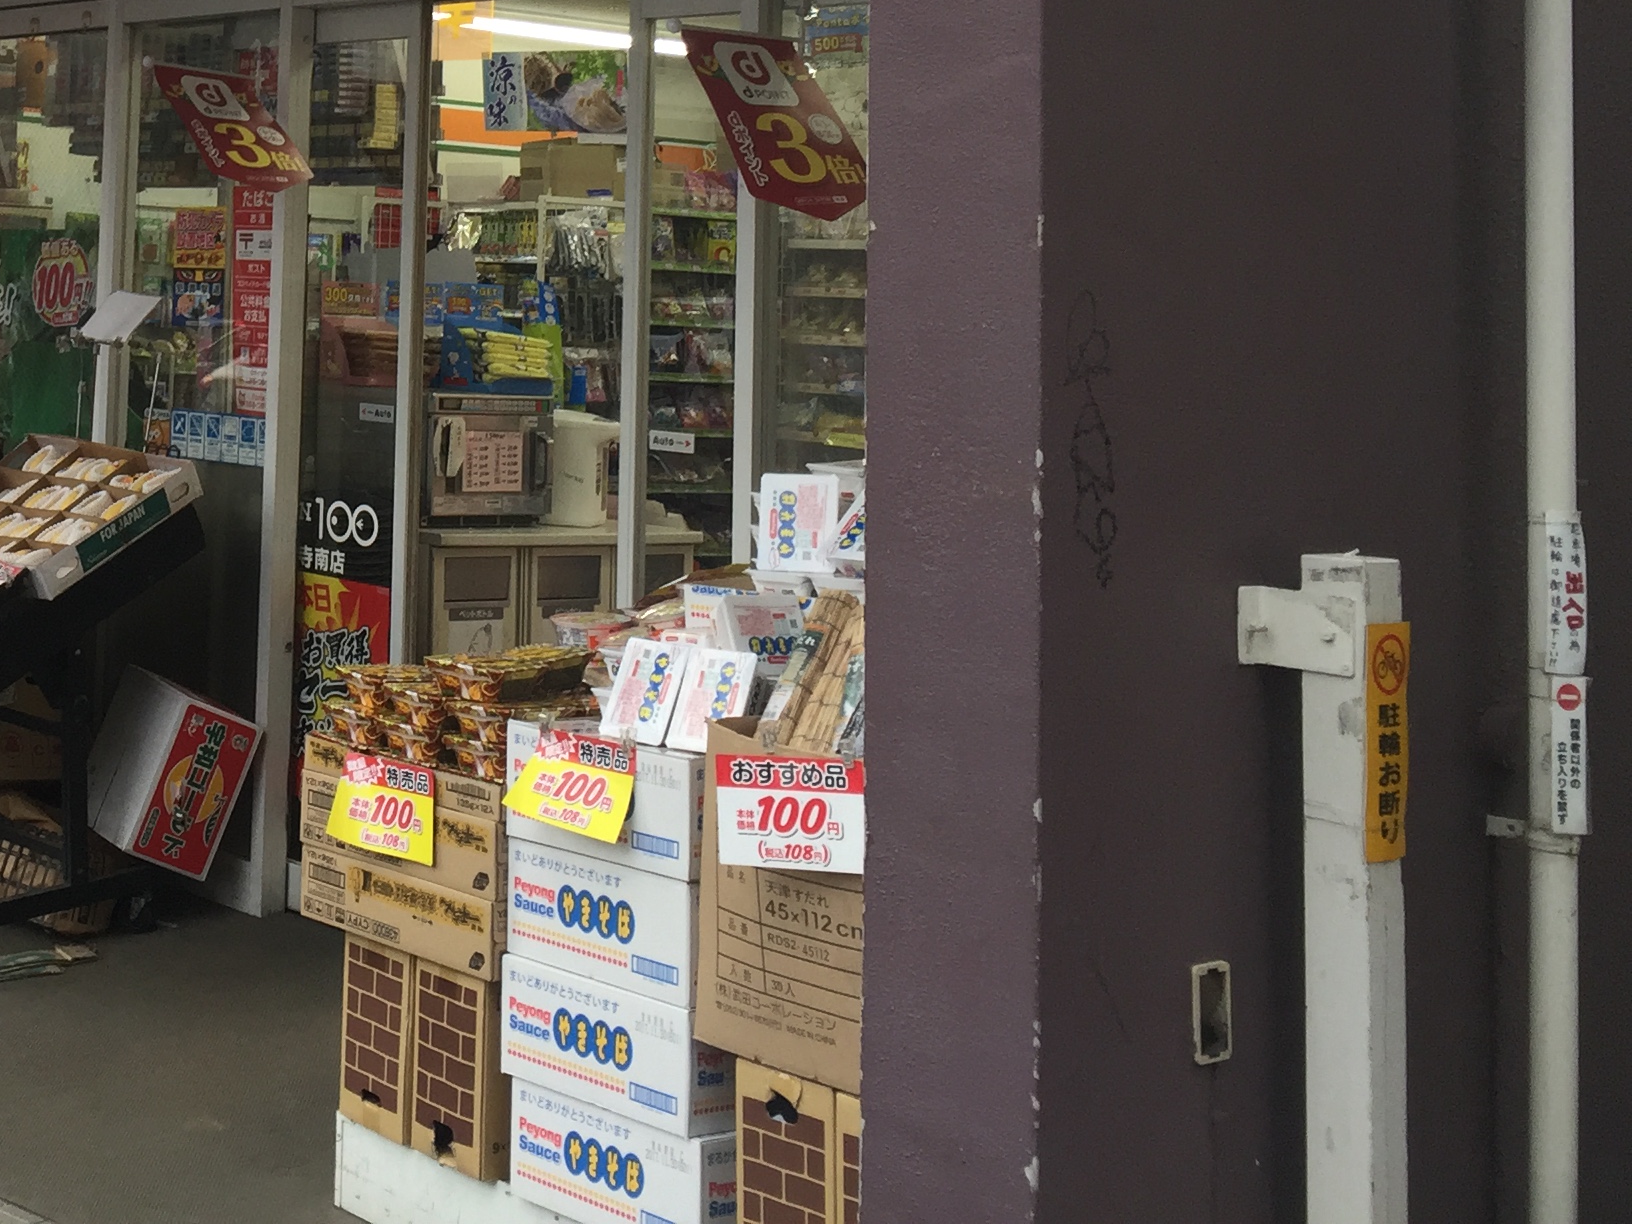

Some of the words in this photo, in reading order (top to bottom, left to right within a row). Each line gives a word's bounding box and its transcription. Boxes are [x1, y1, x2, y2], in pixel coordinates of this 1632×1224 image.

[814, 36, 839, 52] 500
[242, 190, 274, 208] たばこ
[374, 408, 392, 419] Auto
[652, 434, 675, 448] Auto
[99, 523, 118, 543] FOR
[118, 504, 146, 532] JAPAN
[315, 497, 379, 547] 100
[458, 609, 495, 619] ペットボトル
[579, 740, 629, 772] 特売品
[1570, 718, 1581, 790] 関係者以外の
[386, 764, 430, 794] 特売品
[533, 782, 552, 795] 価格
[538, 773, 556, 785] 本体
[731, 760, 848, 791] おすすめ品
[1377, 702, 1402, 845] 駐輪お断り
[351, 797, 370, 809] 本体
[553, 771, 612, 812] 100円
[348, 807, 369, 820] 価格
[370, 794, 423, 834] 100円
[736, 808, 756, 820] 本体
[736, 820, 756, 832] 価格
[757, 795, 842, 838] 100円
[514, 848, 622, 889] まいどありがとうございます
[514, 875, 556, 904] Peyong
[764, 879, 830, 909] 天津すだれ
[514, 893, 555, 919] Sauce
[560, 886, 634, 943] やきそば
[509, 970, 620, 1014] まいどありがとうございます
[509, 996, 552, 1026] Peyong
[509, 1015, 550, 1042] Sauce
[555, 1010, 631, 1069] やきそば
[519, 1088, 632, 1140] まいどありがとうございます
[518, 1115, 563, 1148] Peyong
[518, 1135, 561, 1163] Sauce
[565, 1133, 643, 1196] やきそば
